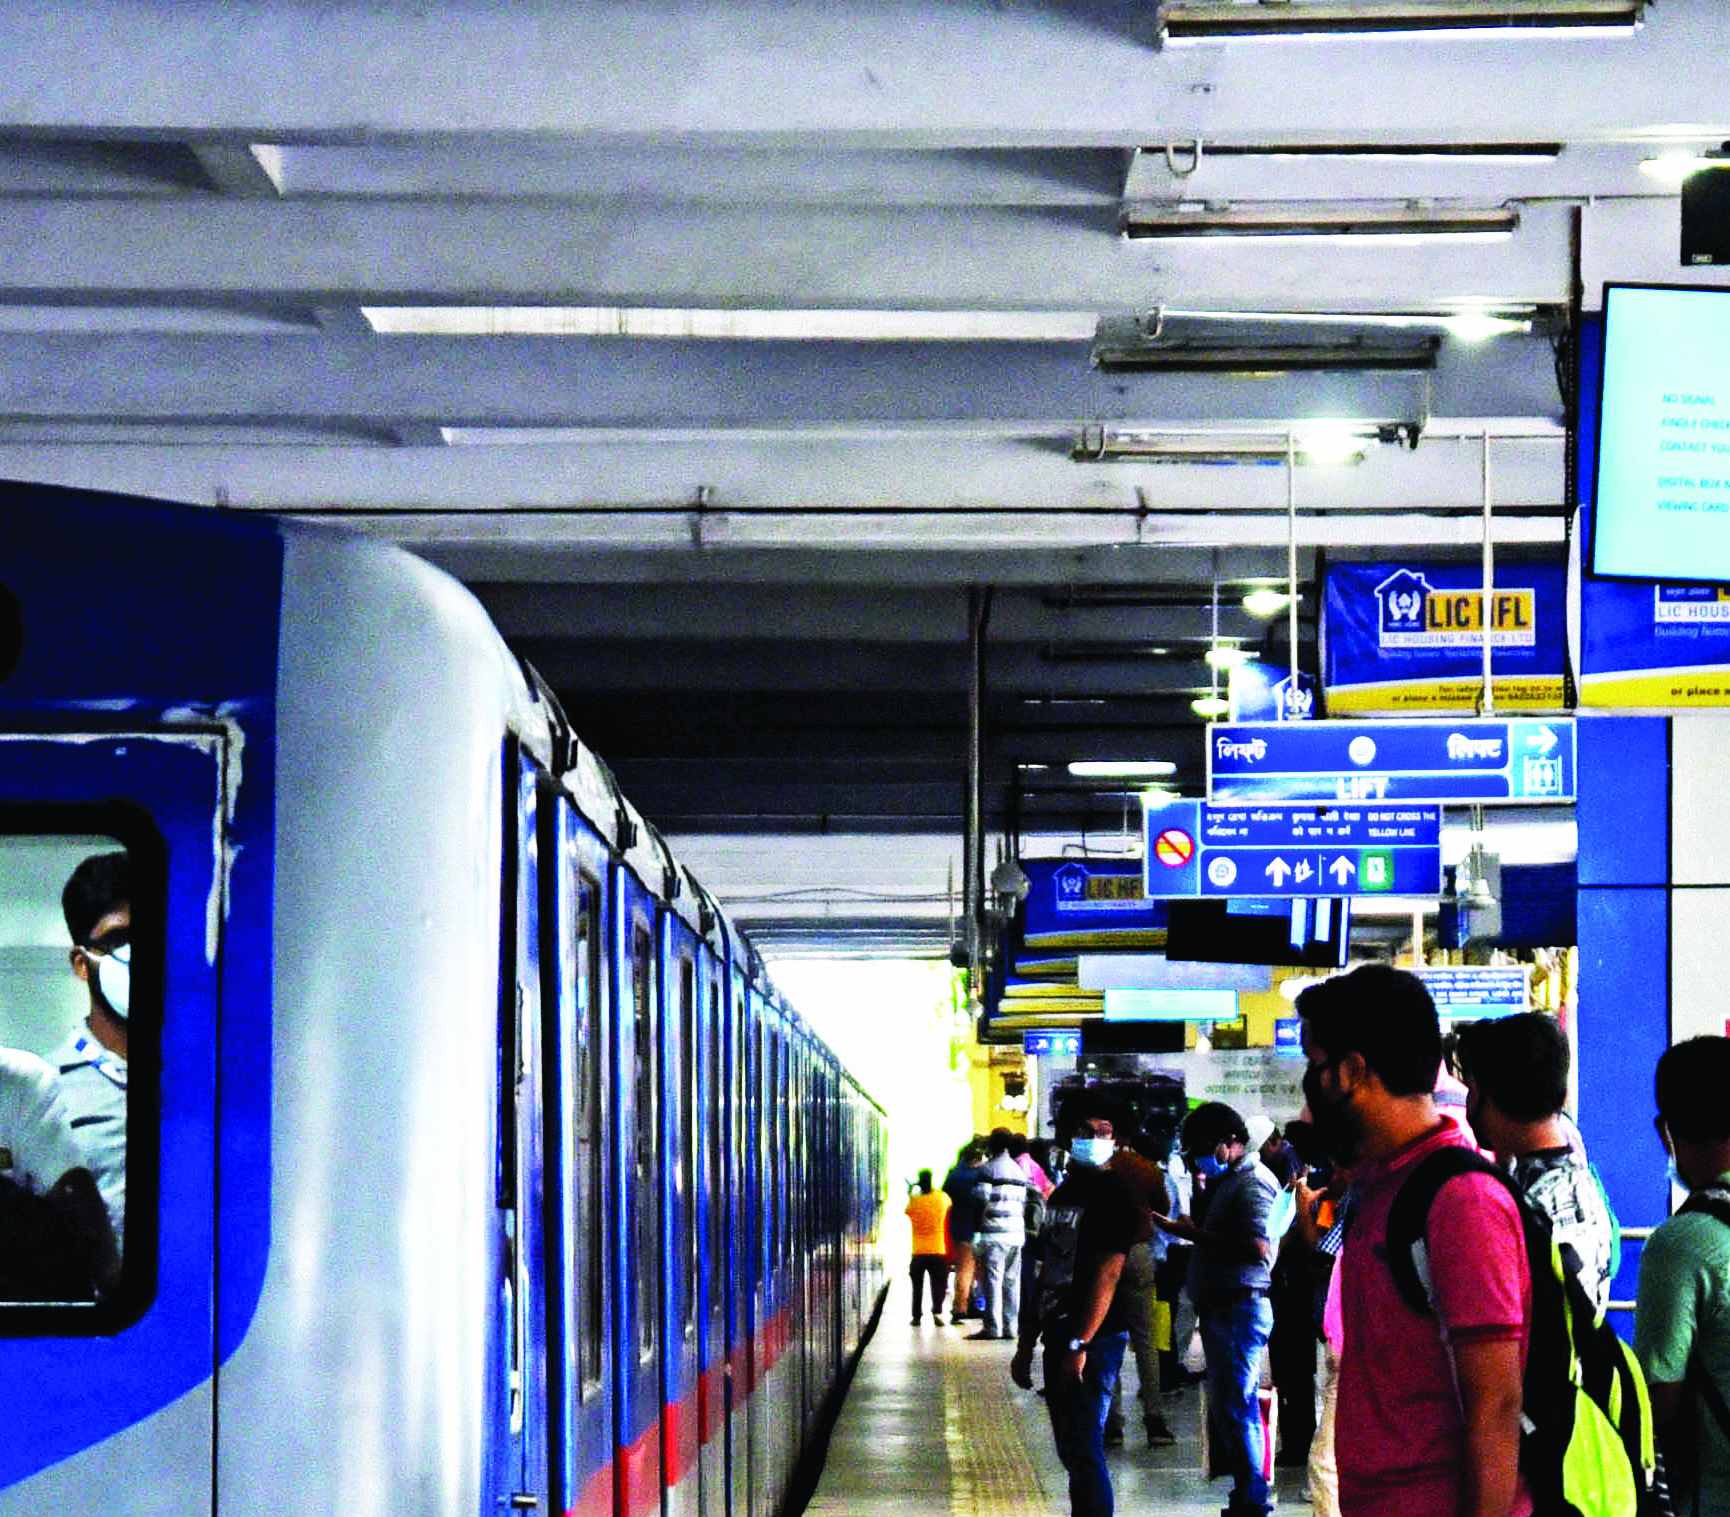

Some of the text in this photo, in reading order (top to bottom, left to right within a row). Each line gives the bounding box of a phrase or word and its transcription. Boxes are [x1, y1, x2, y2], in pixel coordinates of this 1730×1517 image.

[1429, 597, 1470, 627] LIC
[1658, 605, 1683, 618] LIC
[1336, 777, 1390, 799] LIFT
